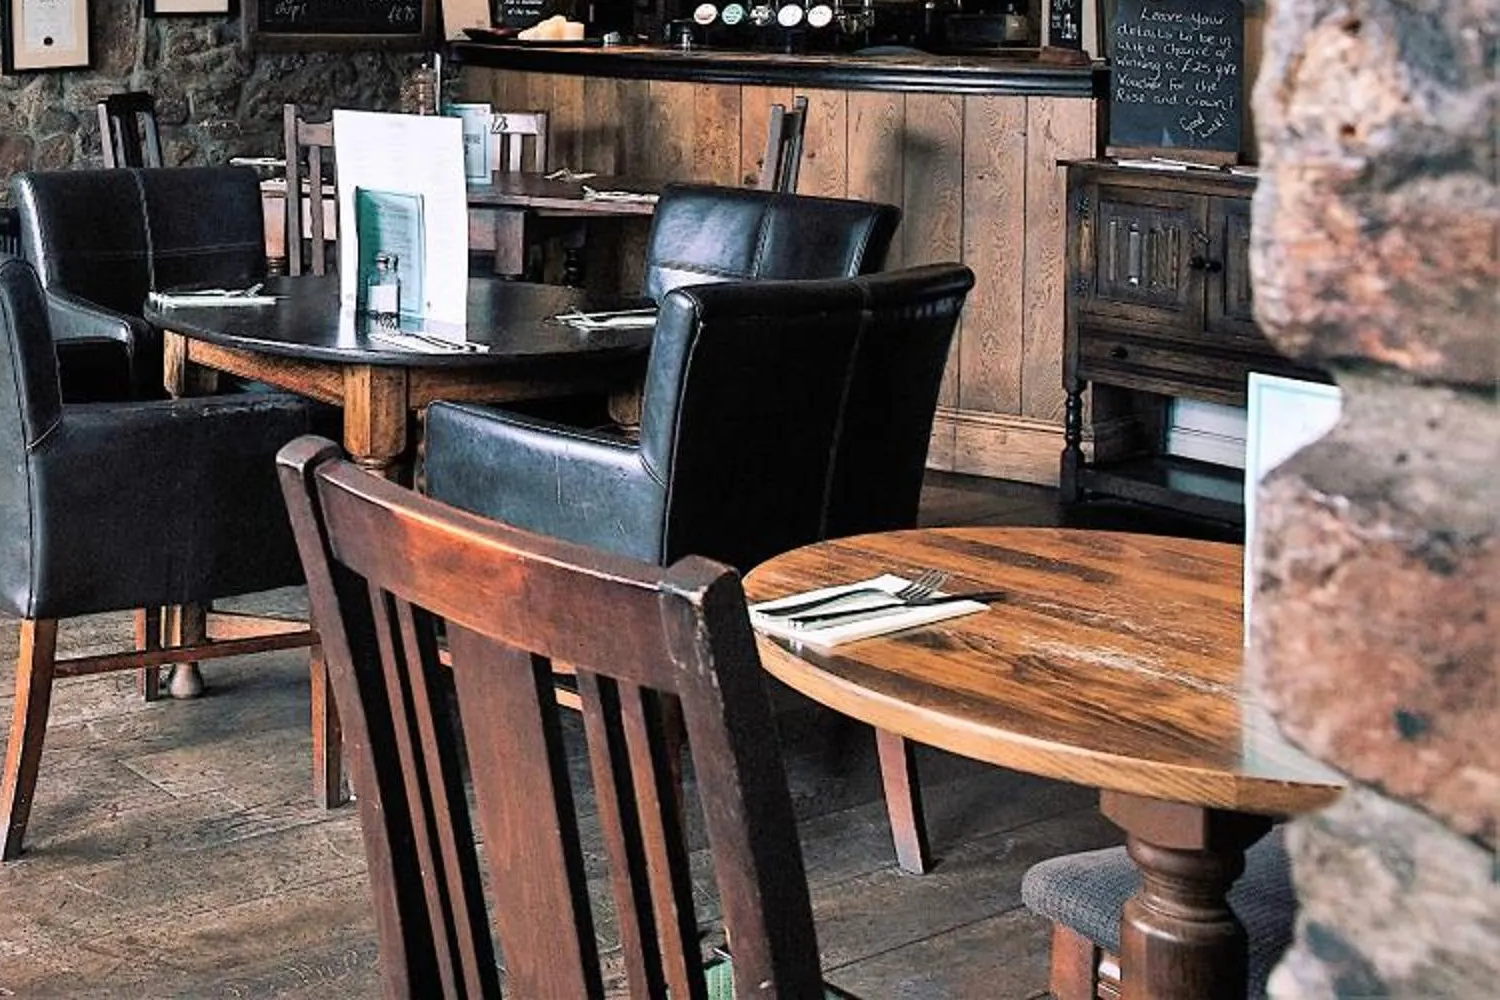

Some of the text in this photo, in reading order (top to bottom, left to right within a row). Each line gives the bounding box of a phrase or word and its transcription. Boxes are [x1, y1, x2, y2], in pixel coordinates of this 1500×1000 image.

[1117, 24, 1173, 39] details
[1179, 31, 1193, 41] to
[1200, 33, 1215, 45] be
[1165, 61, 1177, 71] a
[1181, 58, 1211, 74] £25
[1195, 80, 1218, 94] the
[1153, 95, 1177, 105] and
[1180, 111, 1205, 134] Good
